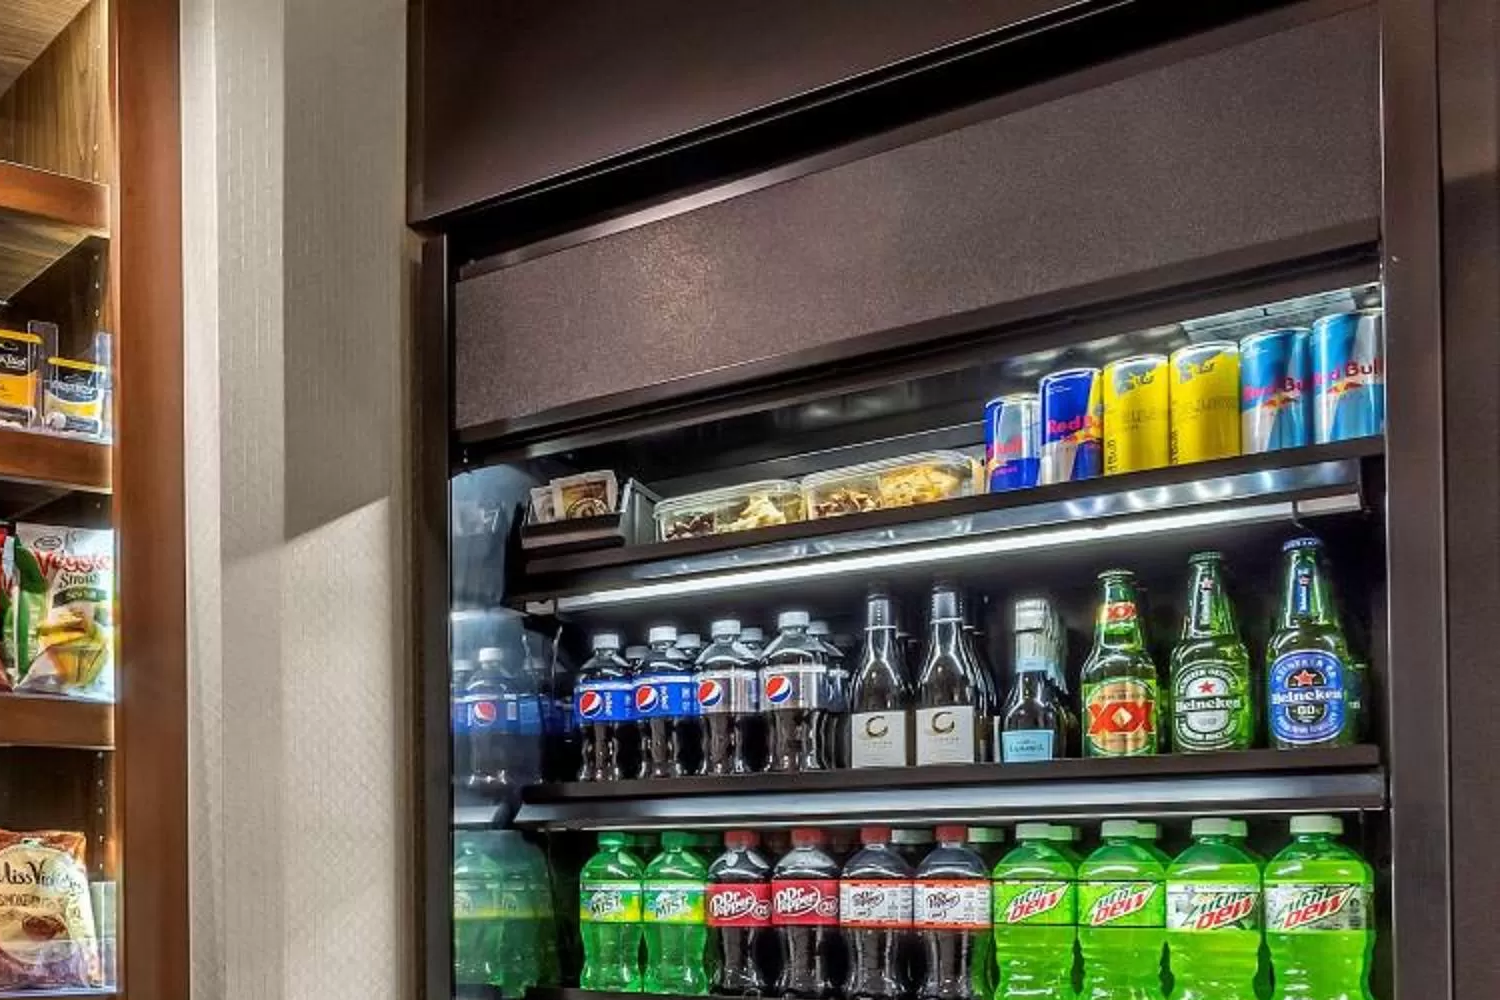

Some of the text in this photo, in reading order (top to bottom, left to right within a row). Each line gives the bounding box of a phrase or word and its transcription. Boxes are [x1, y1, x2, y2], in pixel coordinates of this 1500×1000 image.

[1048, 415, 1083, 433] Red
[34, 550, 111, 577] Veggie
[1175, 699, 1241, 713] Heineken
[1271, 689, 1343, 705] Heineken
[1086, 702, 1156, 736] XX
[725, 890, 740, 904] Dr
[774, 891, 819, 915] Pepper
[789, 887, 804, 901] Dr
[708, 894, 757, 918] Pepper
